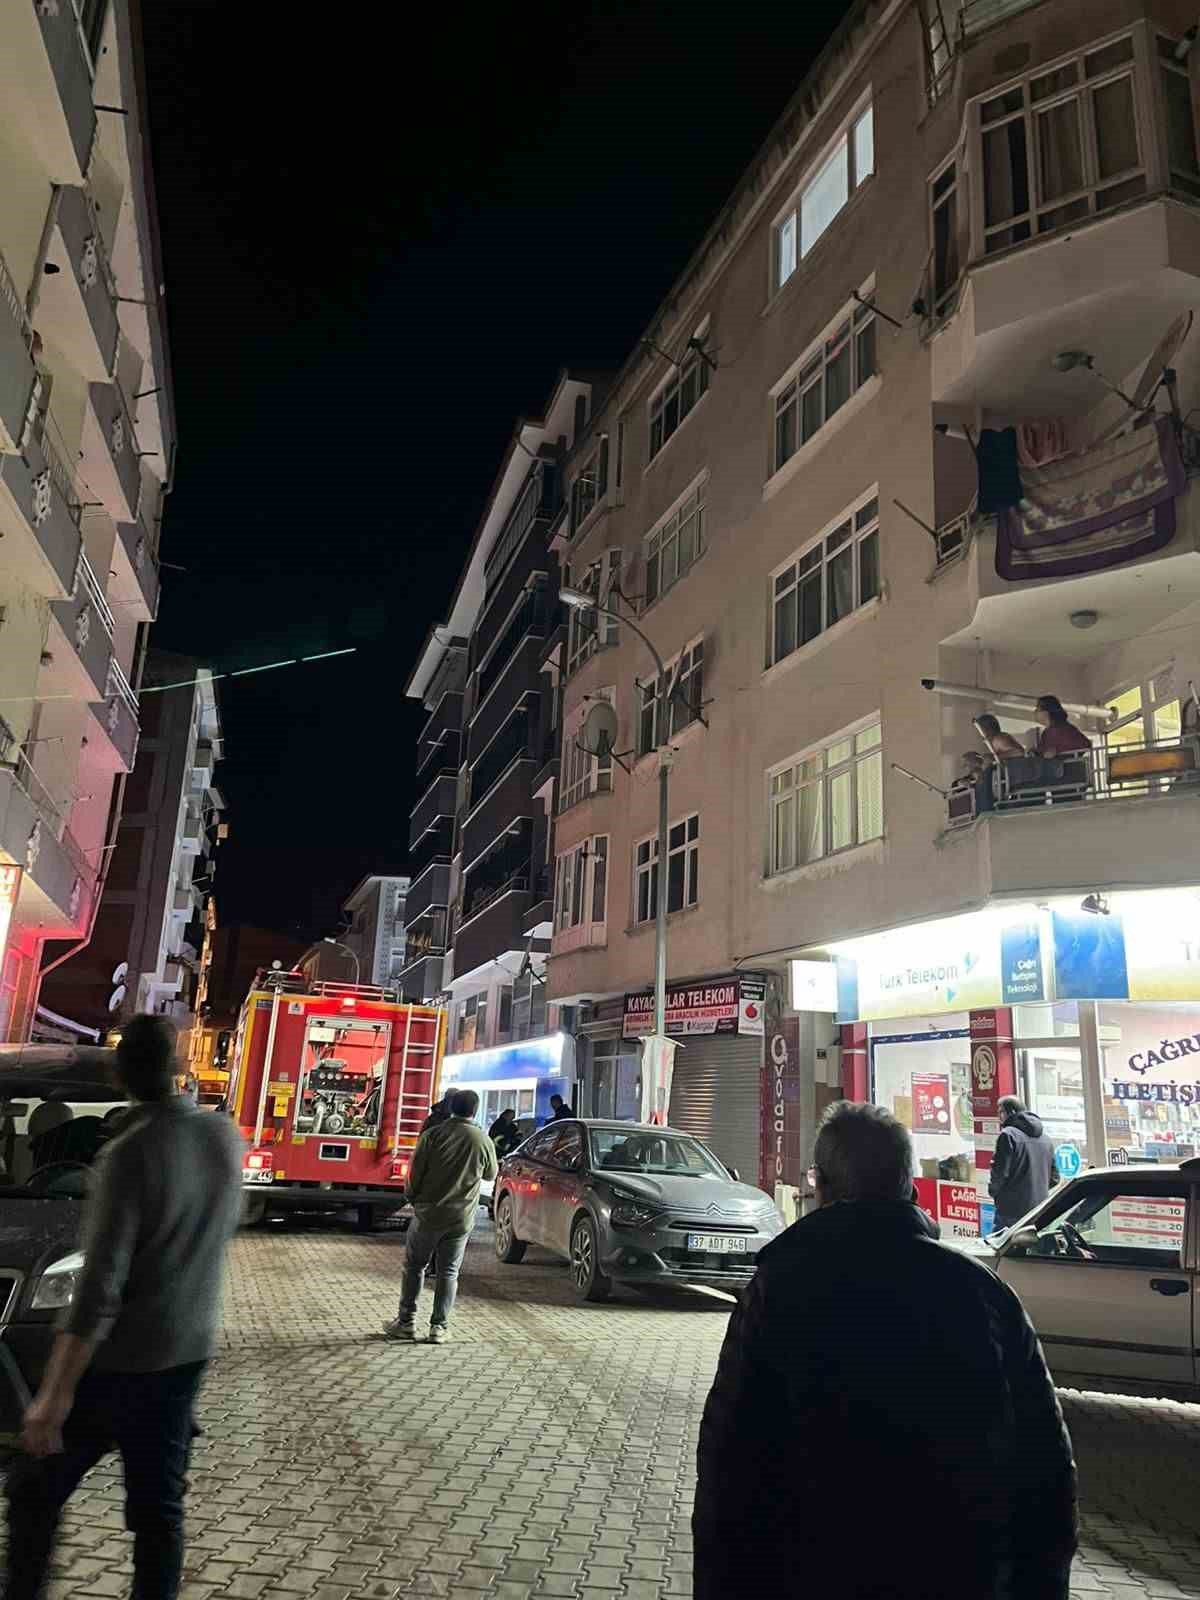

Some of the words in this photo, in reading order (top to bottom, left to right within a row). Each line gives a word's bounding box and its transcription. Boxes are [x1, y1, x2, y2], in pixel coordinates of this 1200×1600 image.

[906, 966, 958, 985] Telekom
[687, 986, 735, 1007] TELEKOM
[1112, 1078, 1200, 1107] İLETİŞİ
[774, 1064, 785, 1185] vodafo
[951, 1188, 977, 1202] ÇAĞR
[1168, 1207, 1181, 1216] 10
[1168, 1223, 1183, 1231] 20
[693, 1236, 704, 1248] 37
[708, 1238, 725, 1249] ADT
